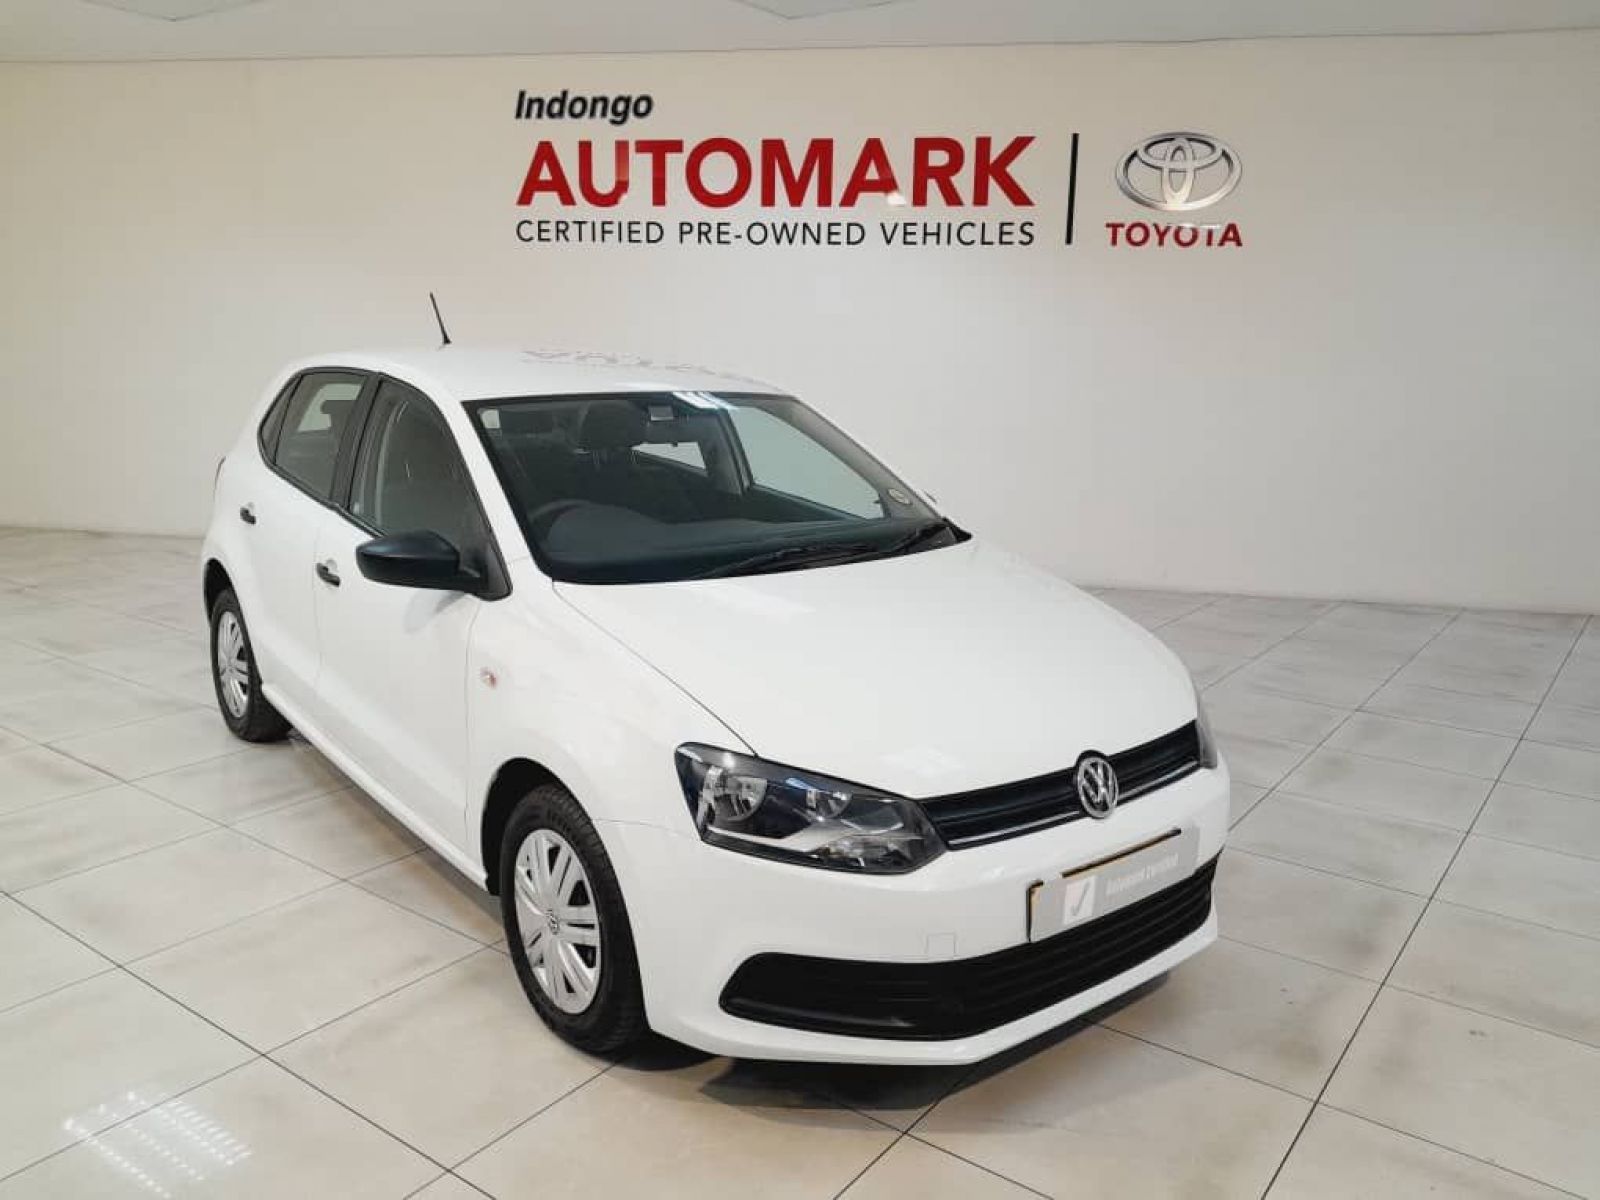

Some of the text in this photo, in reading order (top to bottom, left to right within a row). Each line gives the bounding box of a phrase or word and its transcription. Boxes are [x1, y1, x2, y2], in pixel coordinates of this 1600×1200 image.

[514, 90, 653, 126] Indongo
[516, 137, 1035, 209] AUTOMARK
[515, 220, 1035, 246] CERTIFIED PRE-OWNED VEHICLES
[1106, 221, 1243, 248] TOYOTA
